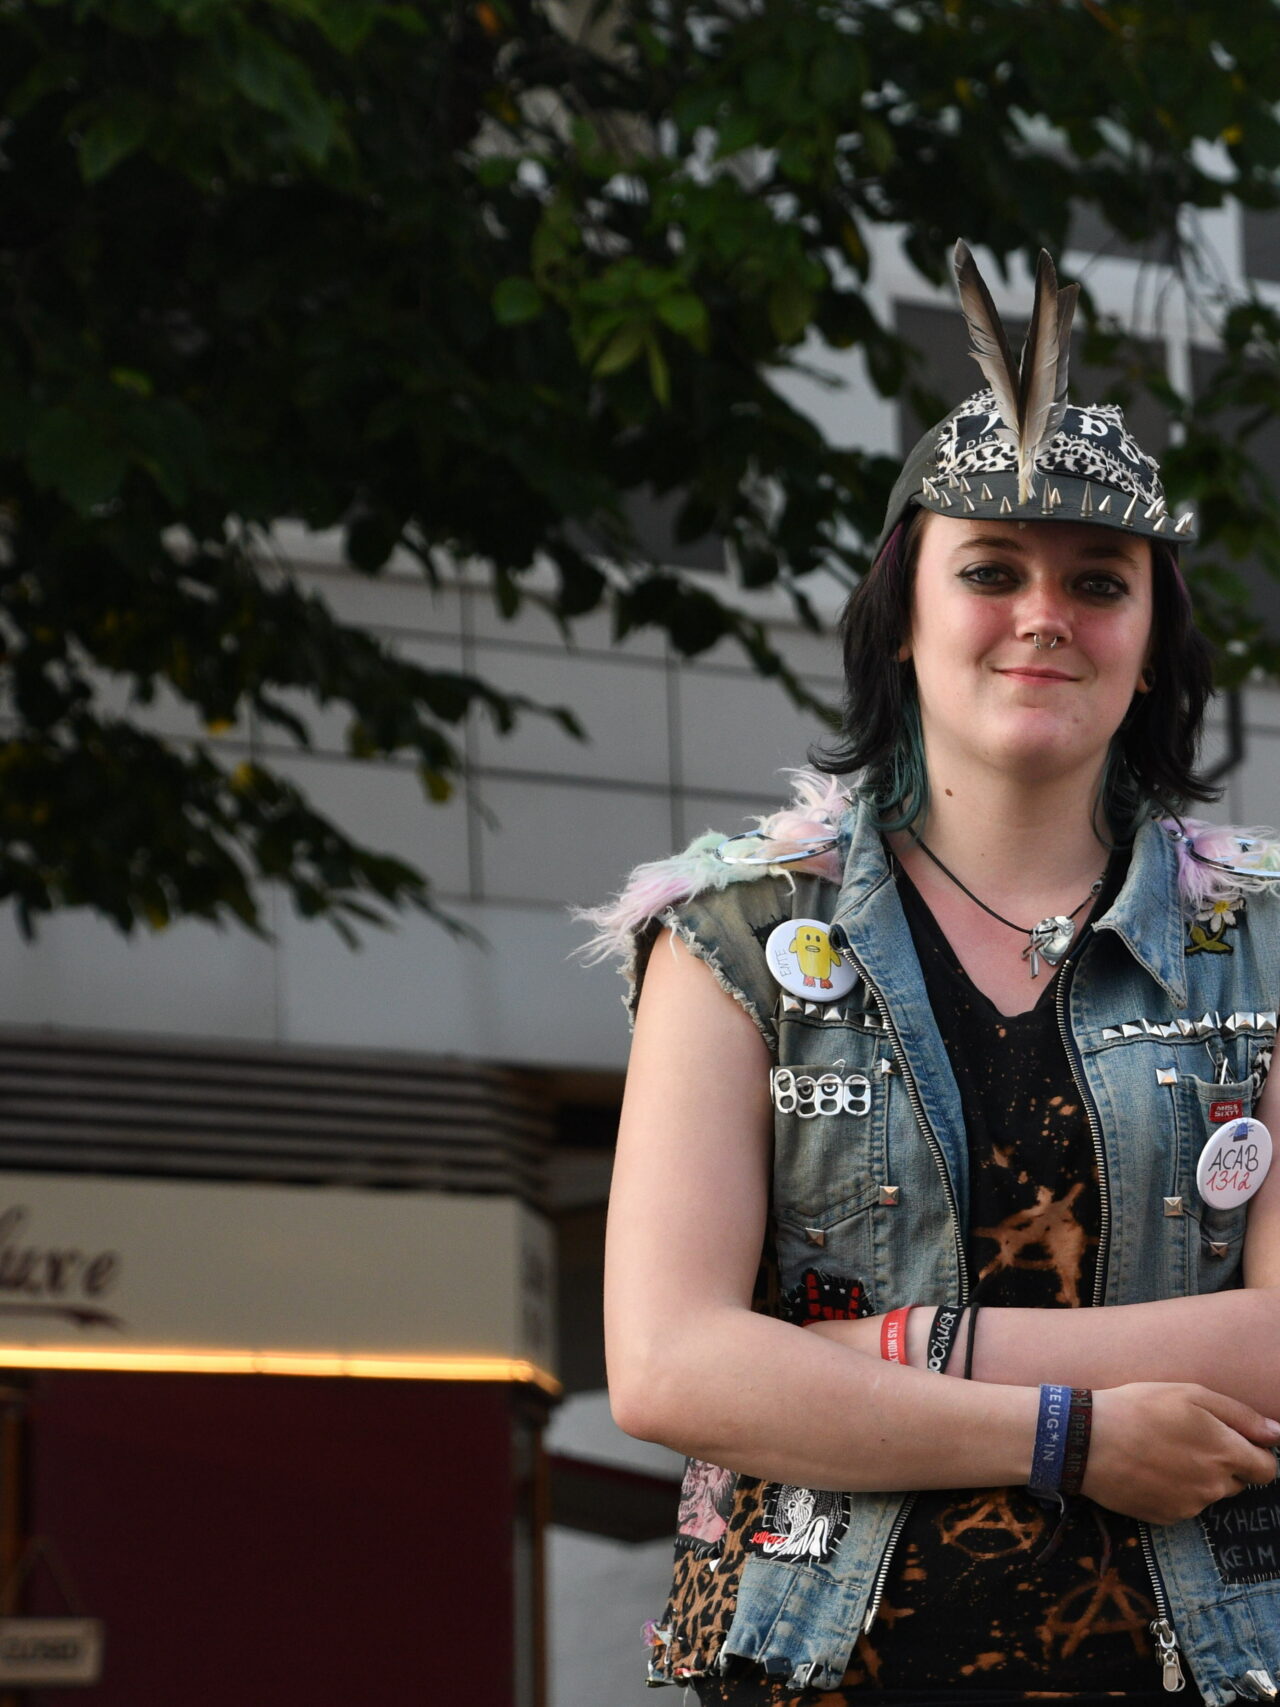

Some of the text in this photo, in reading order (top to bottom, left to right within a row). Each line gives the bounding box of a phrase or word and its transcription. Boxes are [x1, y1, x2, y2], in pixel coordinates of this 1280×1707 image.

[966, 434, 993, 451] Die
[1207, 1143, 1259, 1172] ACAB
[1206, 1170, 1251, 1191] 1312
[1219, 1544, 1277, 1571] KEIM
